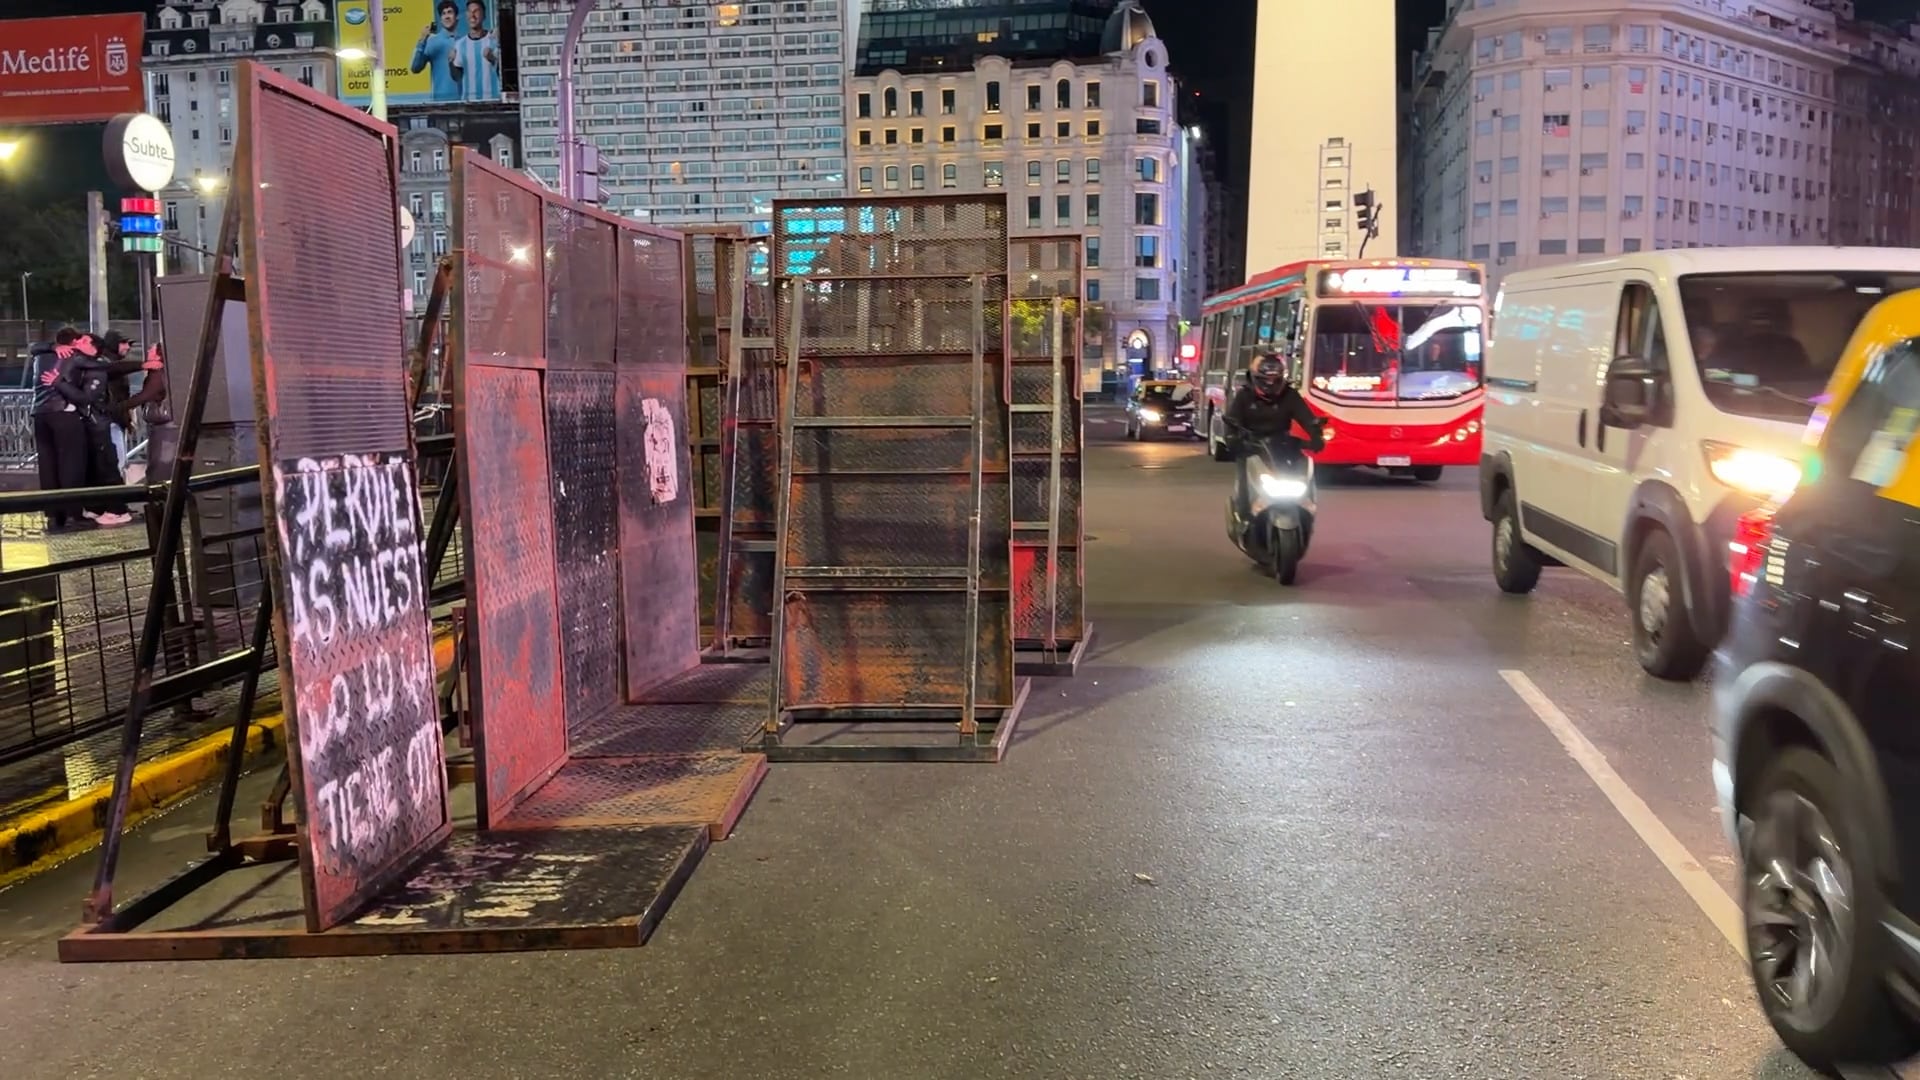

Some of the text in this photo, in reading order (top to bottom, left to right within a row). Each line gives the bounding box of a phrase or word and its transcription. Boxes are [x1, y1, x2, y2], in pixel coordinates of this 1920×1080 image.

[1, 46, 90, 75] Medifé
[348, 80, 369, 90] otra
[129, 137, 168, 159] Subte
[317, 747, 399, 850] TIENE
